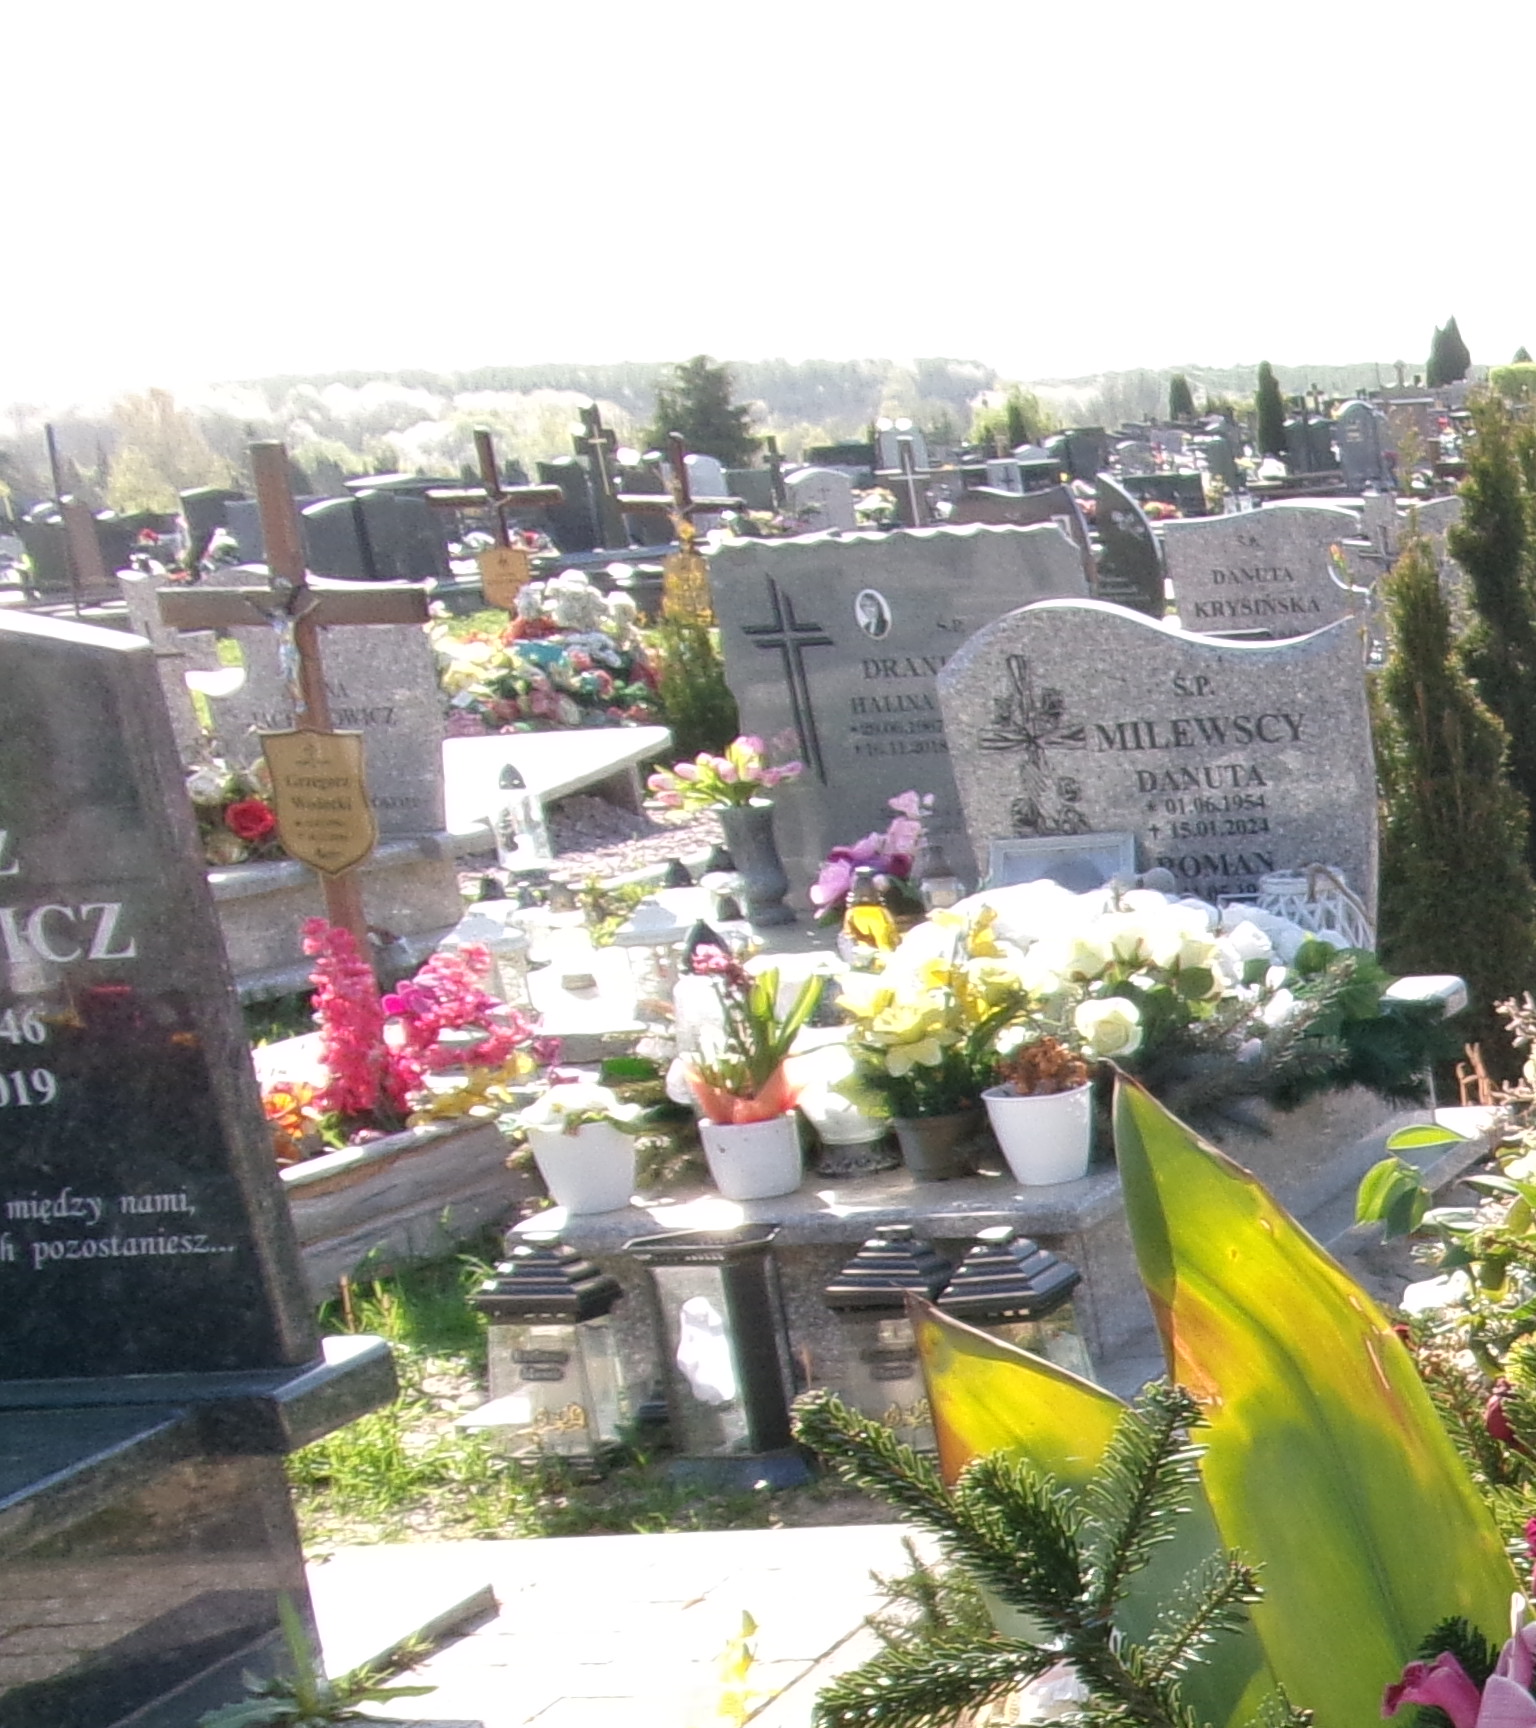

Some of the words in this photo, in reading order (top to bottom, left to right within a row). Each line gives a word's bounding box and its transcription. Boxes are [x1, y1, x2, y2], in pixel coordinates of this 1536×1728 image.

[1212, 567, 1294, 585] DANUTA
[851, 694, 934, 714] HALINA
[1095, 713, 1305, 750] MILEWSCY
[1135, 764, 1267, 793] DANUTA
[1156, 851, 1275, 878] ROMAN
[7, 1187, 100, 1226] między
[121, 1186, 195, 1216] nami,
